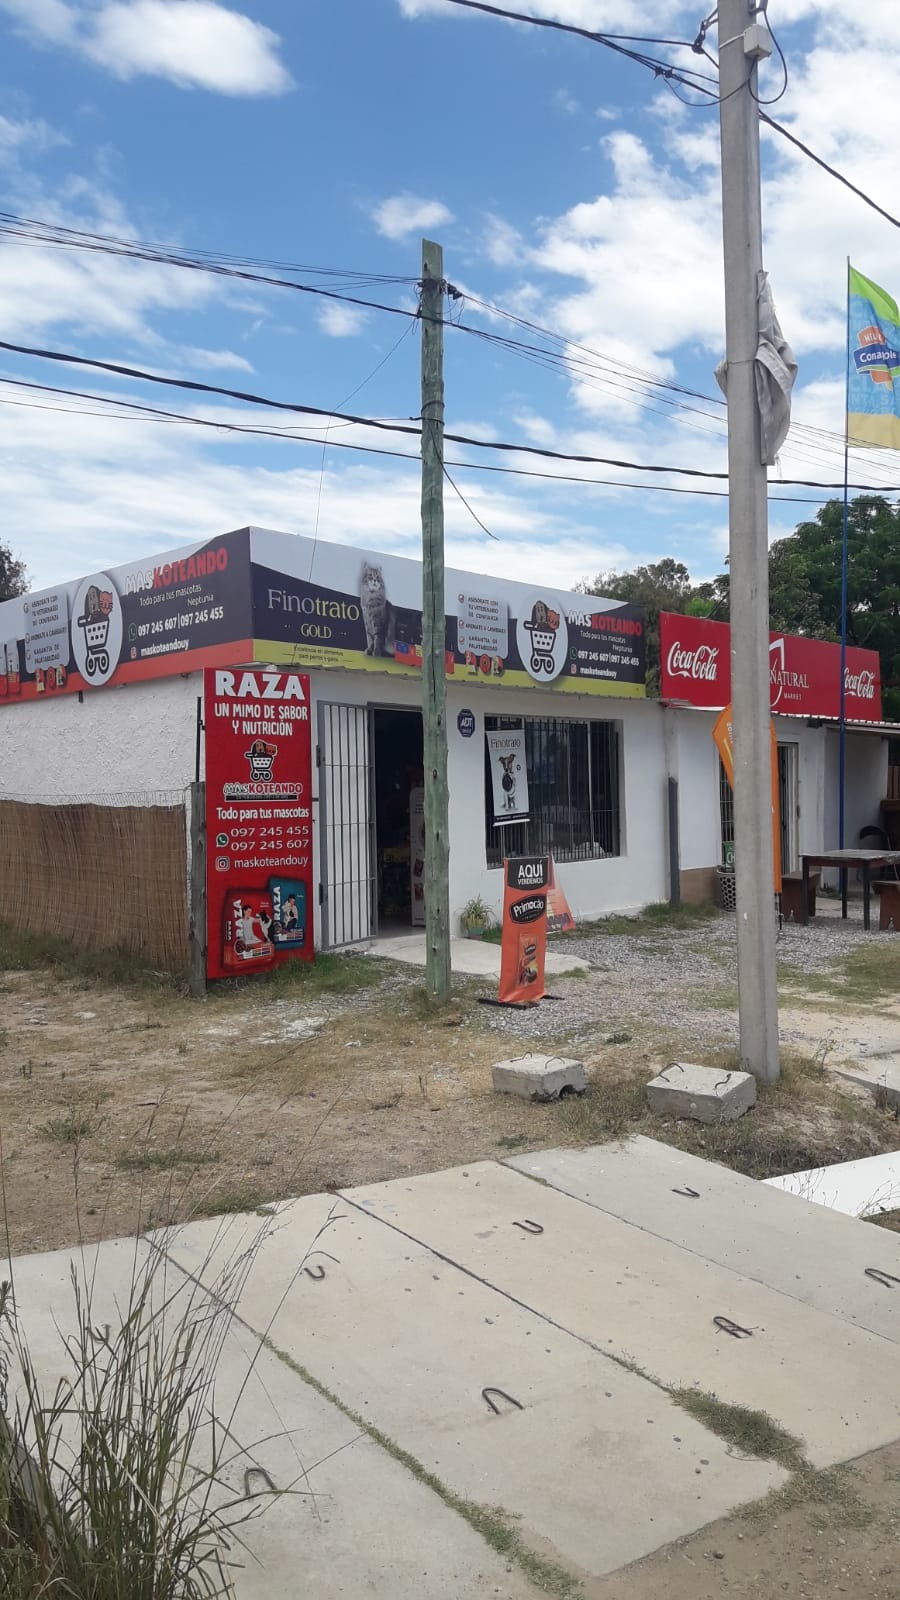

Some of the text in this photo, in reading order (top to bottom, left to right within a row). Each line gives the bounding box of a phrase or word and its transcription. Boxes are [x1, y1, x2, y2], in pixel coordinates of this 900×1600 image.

[124, 547, 228, 593] MASKOTEANDO
[139, 584, 202, 607] Todo para tus mascotas
[267, 588, 360, 621] Finotrato
[300, 623, 332, 639] GOLD
[568, 609, 643, 637] MASKOTEANDO
[140, 638, 190, 657] maskoteandouy
[666, 641, 719, 681] Coca-Cola
[215, 670, 305, 700] RAZA
[770, 670, 810, 688] NATURAL
[844, 667, 876, 699] oca-Cola
[214, 702, 308, 720] UN MIMO DE SABOR
[232, 719, 293, 736] Y NUTRICIÓN
[223, 782, 303, 795] MASKOTEANDO
[216, 807, 309, 822] Todo para tus mascotas
[230, 825, 309, 838] 097 245 455
[230, 839, 309, 851] 097 245 607
[234, 855, 309, 869] maskoteandouy
[518, 860, 543, 878] AQUÍ
[517, 877, 543, 885] VENDEMOS
[273, 886, 281, 921] RAZA
